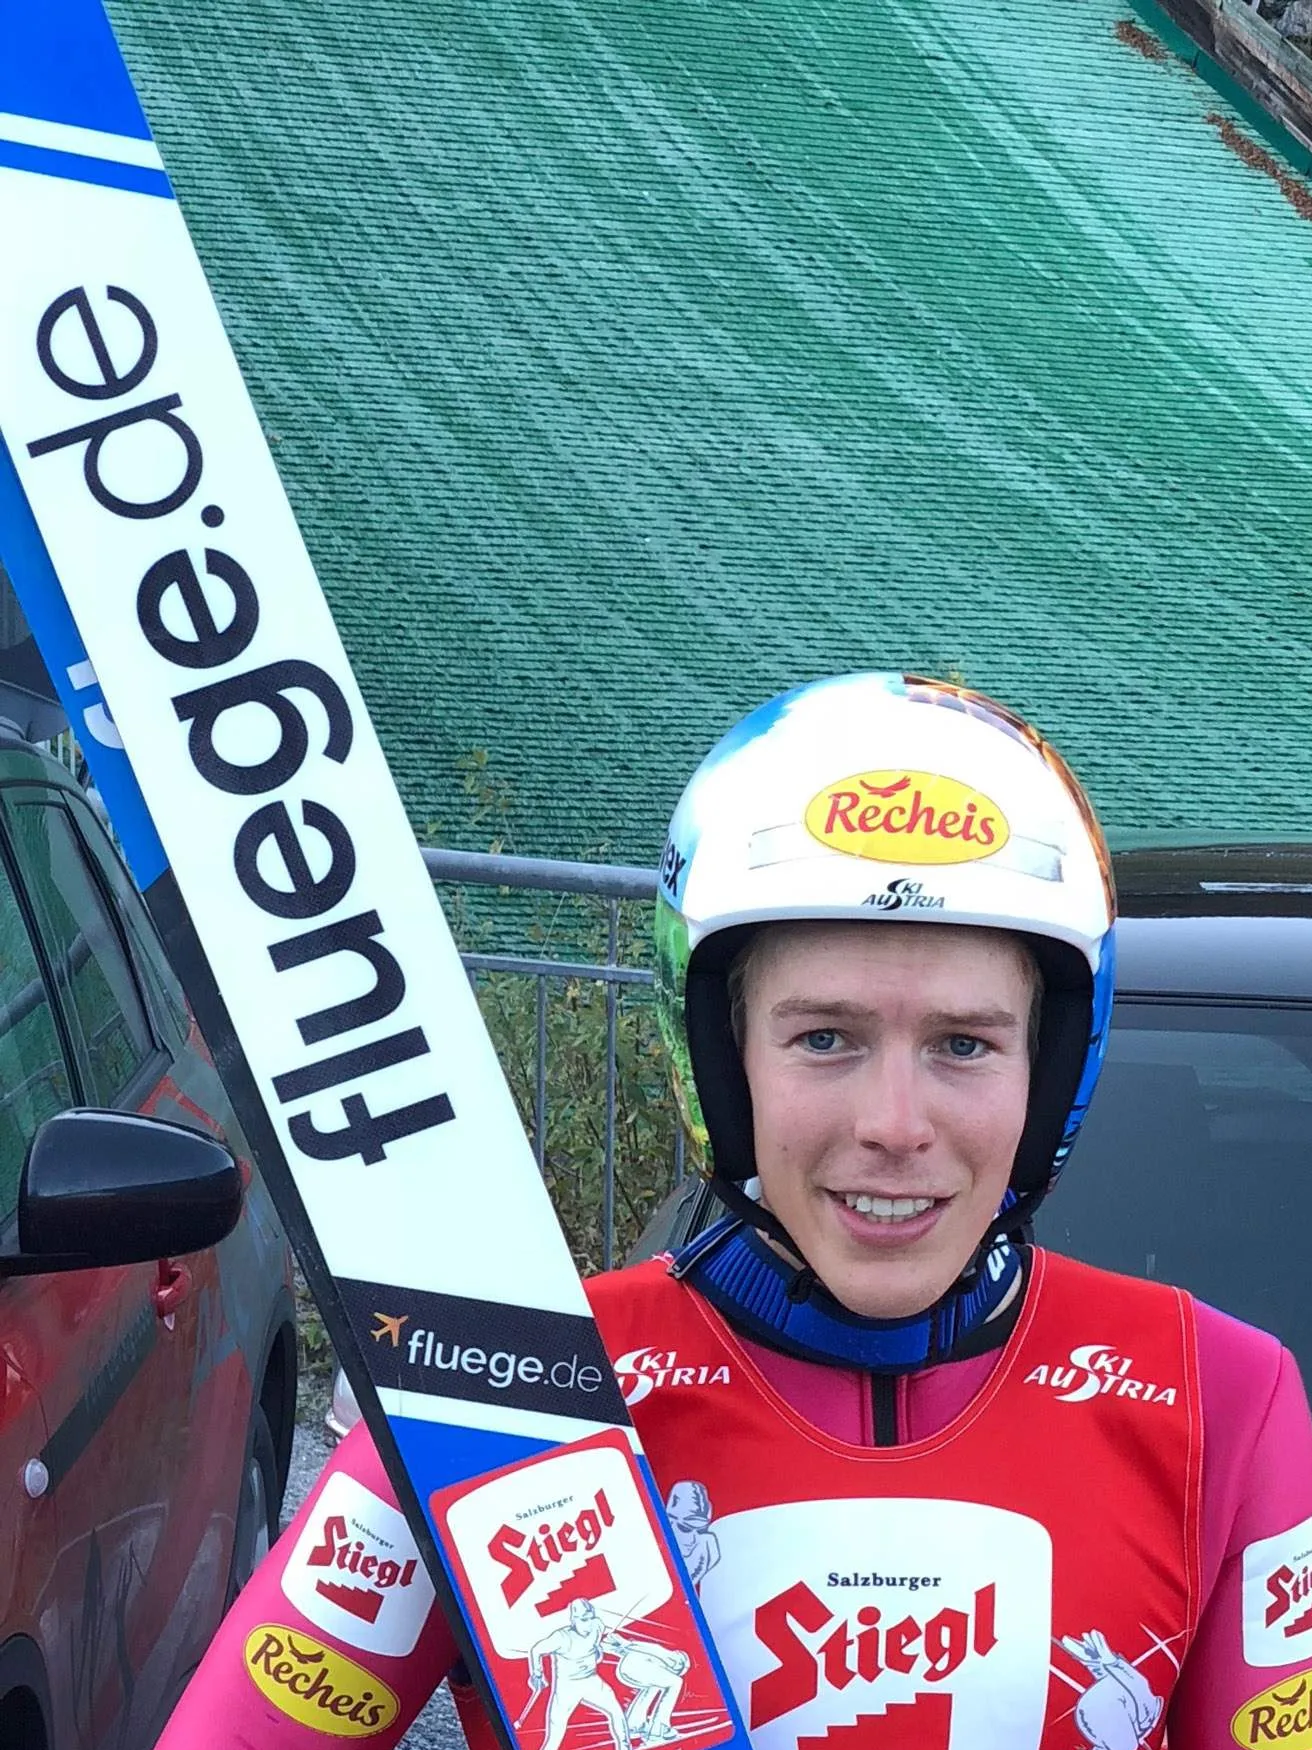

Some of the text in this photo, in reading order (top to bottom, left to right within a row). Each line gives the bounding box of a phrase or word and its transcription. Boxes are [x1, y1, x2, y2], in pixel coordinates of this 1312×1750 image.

[26, 284, 457, 1167] fluege.de
[824, 790, 996, 846] Recheis
[861, 889, 946, 911] AUSTRIA
[407, 1329, 603, 1392] fluege.de
[614, 1346, 678, 1373] SKI
[1069, 1344, 1134, 1378] SKI
[617, 1366, 731, 1406] STRIA
[1023, 1363, 1177, 1407] AUSTRIA
[515, 1493, 575, 1522] Salzburger
[306, 1515, 418, 1588] Stiegl
[487, 1487, 616, 1610] Stiegl
[827, 1570, 942, 1591] Salzburger
[750, 1579, 999, 1732] Stiegl
[251, 1634, 384, 1728] Recheis
